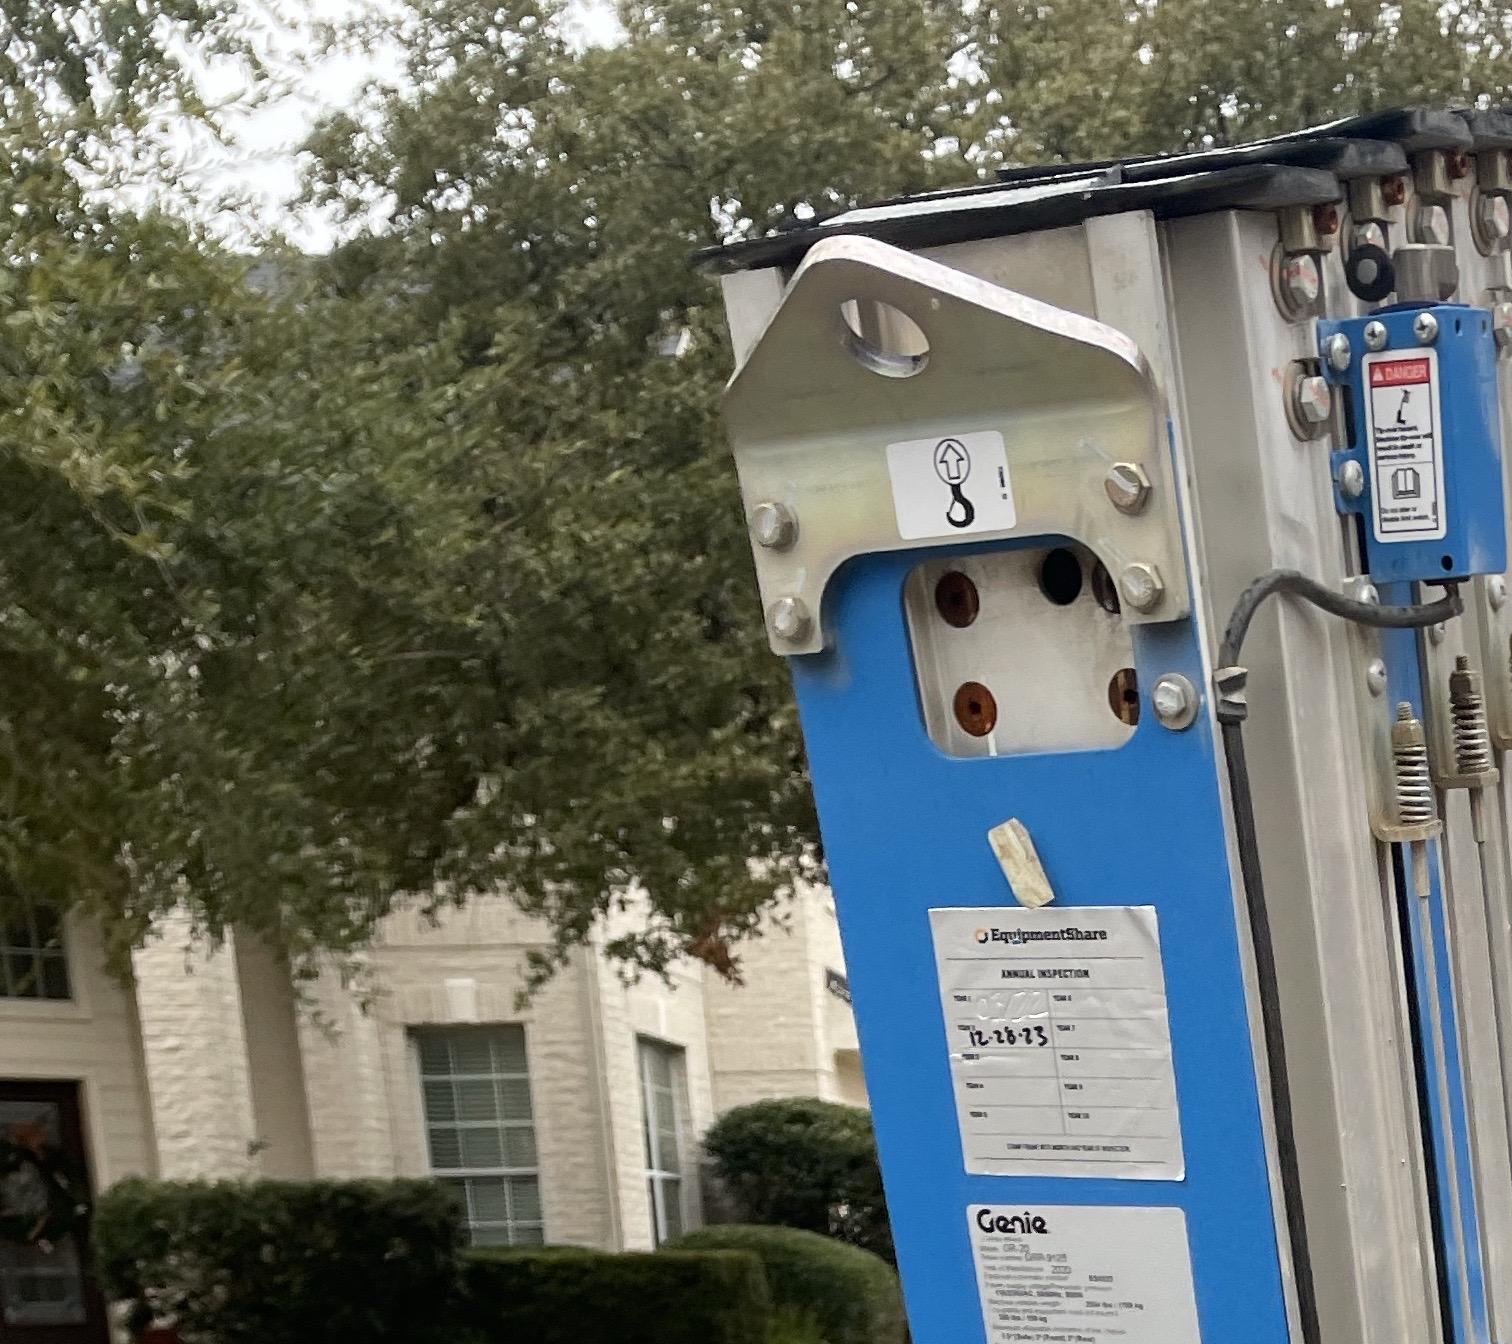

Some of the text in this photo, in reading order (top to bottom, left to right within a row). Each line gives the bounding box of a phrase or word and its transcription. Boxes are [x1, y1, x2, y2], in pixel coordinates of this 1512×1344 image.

[1384, 364, 1427, 382] DANGER
[991, 927, 1107, 944] EquipmentShare
[1001, 968, 1090, 979] ANNUAL INSPECTION
[977, 1209, 1048, 1234] Genie
